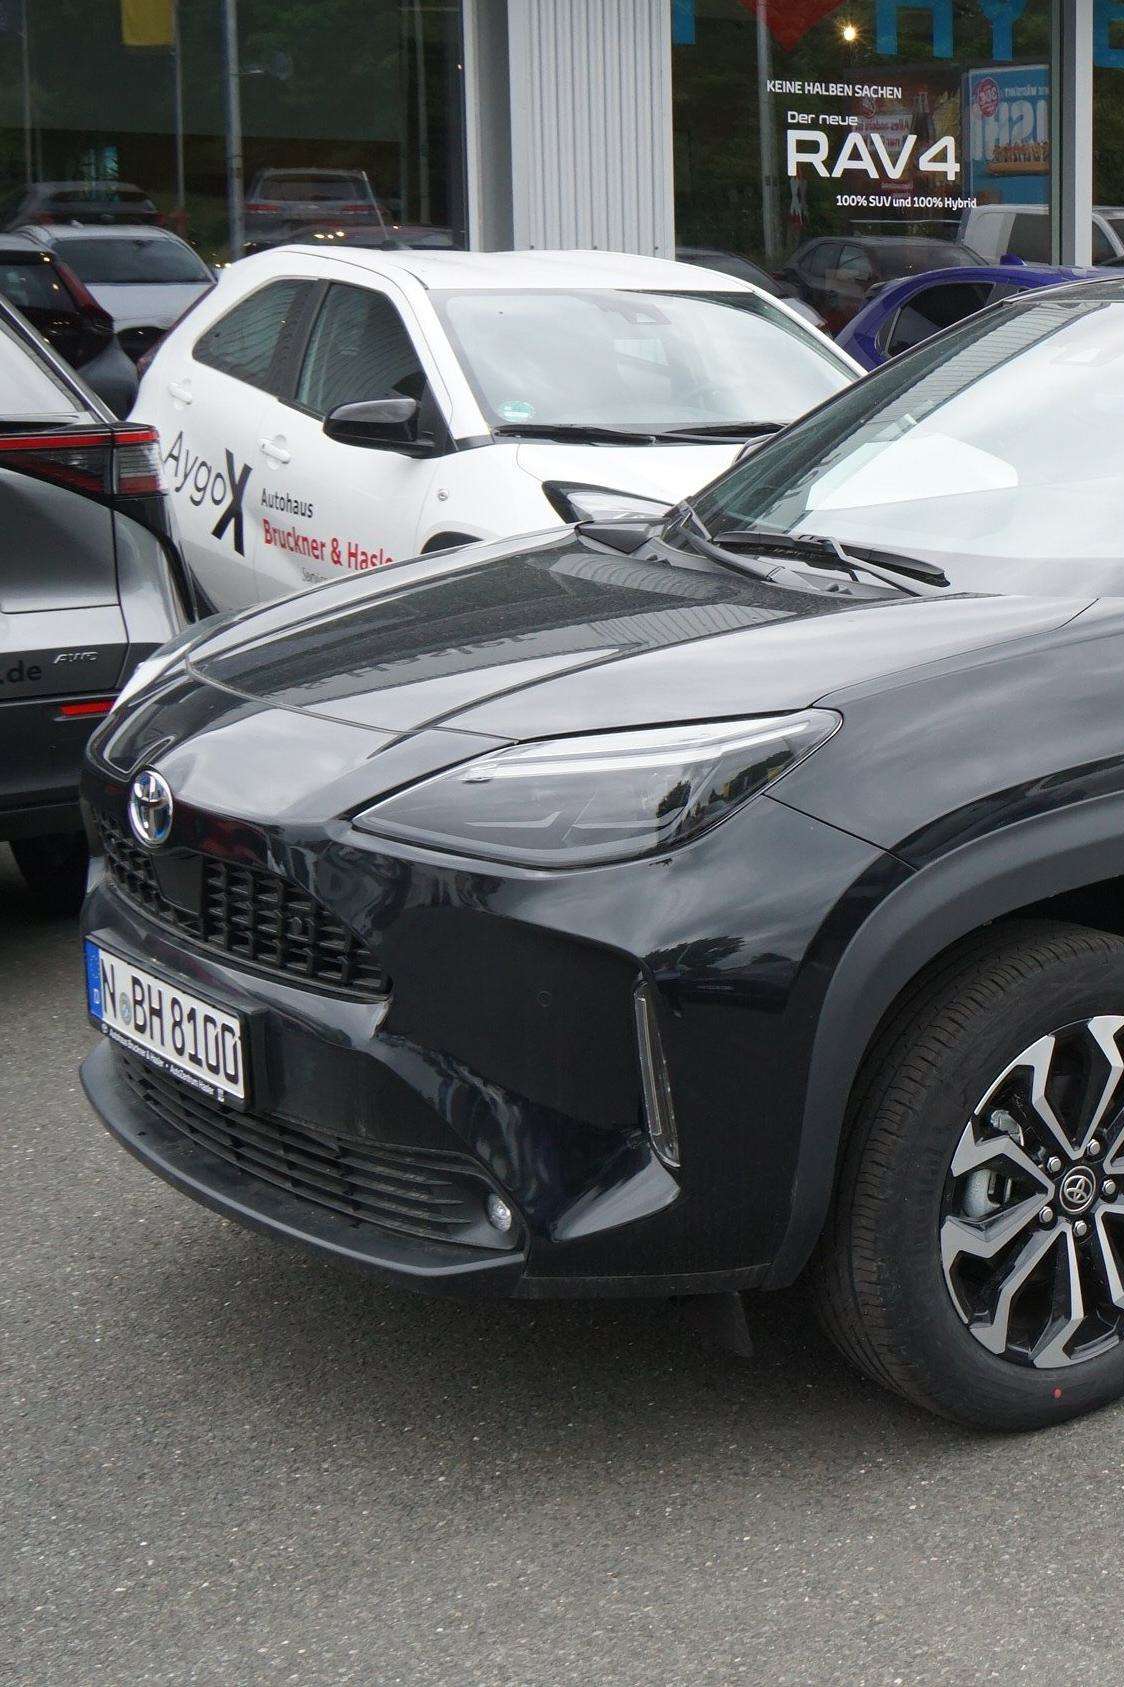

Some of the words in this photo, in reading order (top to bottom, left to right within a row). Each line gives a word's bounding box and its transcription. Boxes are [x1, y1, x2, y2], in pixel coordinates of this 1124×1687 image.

[766, 80, 803, 94] KEINE
[804, 82, 853, 97] HALBEN
[854, 84, 902, 99] SACHEN
[787, 111, 815, 124] Der
[818, 113, 858, 126] neue
[786, 129, 961, 181] RAV4
[836, 194, 867, 207] 100%
[868, 195, 893, 208] SUV
[892, 196, 912, 208] und
[912, 196, 943, 209] 100%
[944, 197, 978, 211] Hybrid
[163, 430, 227, 507] Aygo
[211, 447, 253, 557] X
[260, 487, 314, 519] Autohaus
[262, 517, 326, 562] Bruckner
[330, 537, 343, 567] &
[101, 958, 117, 1019] N
[131, 975, 165, 1047] BH
[170, 996, 240, 1086] 8100
